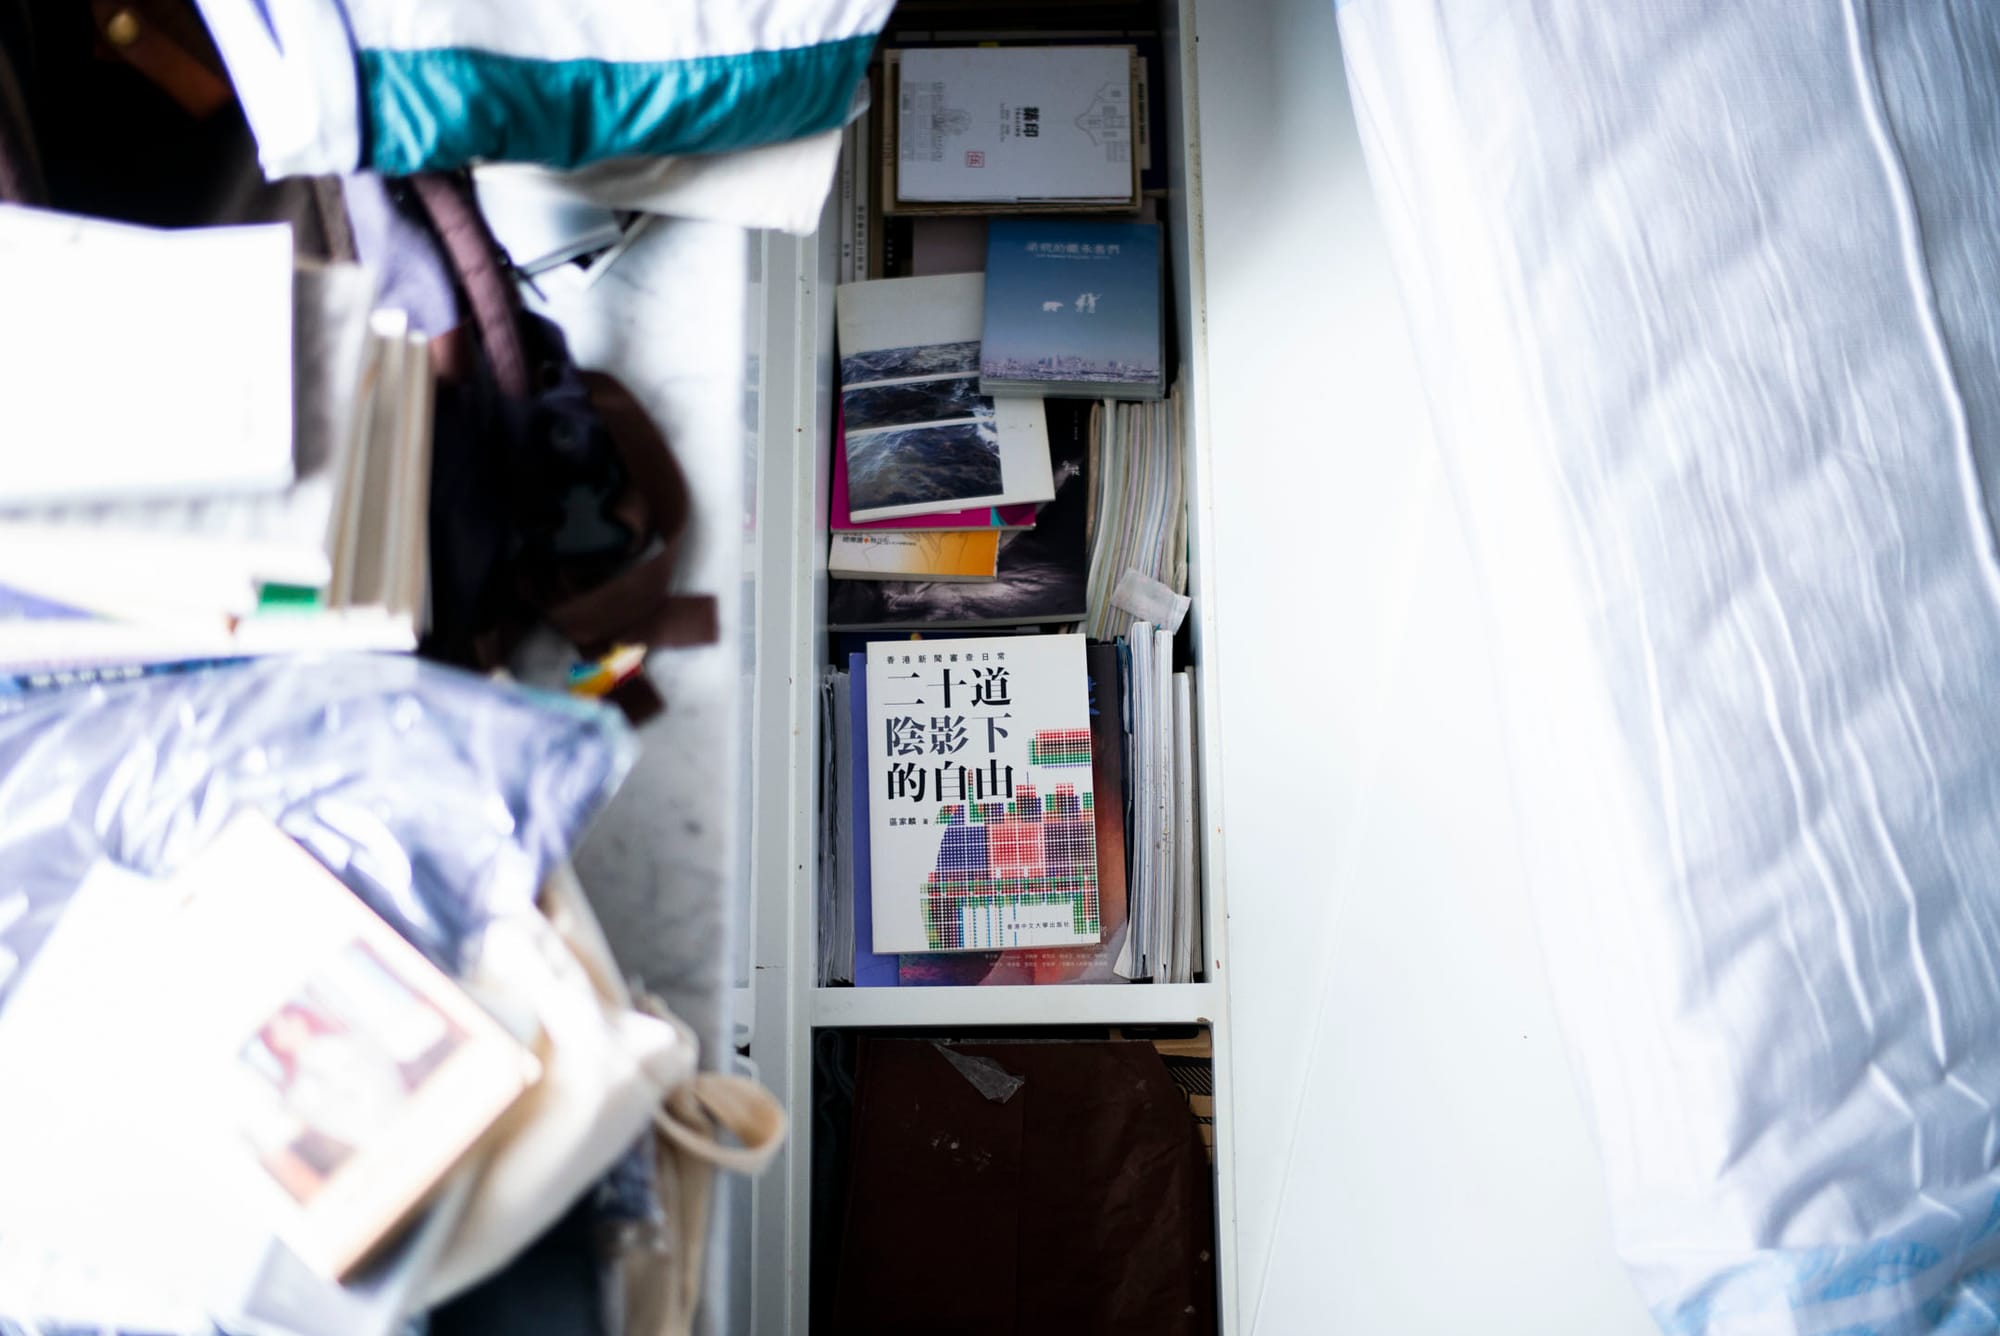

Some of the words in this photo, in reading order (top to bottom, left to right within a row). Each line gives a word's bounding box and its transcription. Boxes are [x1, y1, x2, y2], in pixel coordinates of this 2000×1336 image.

[887, 652, 1005, 664] 香港新聞審查日常
[884, 667, 1011, 709] 二十道
[885, 712, 1012, 756] 陰影下
[887, 759, 1014, 802] 的自由
[1007, 921, 1071, 930] 香港中文大學出版社
